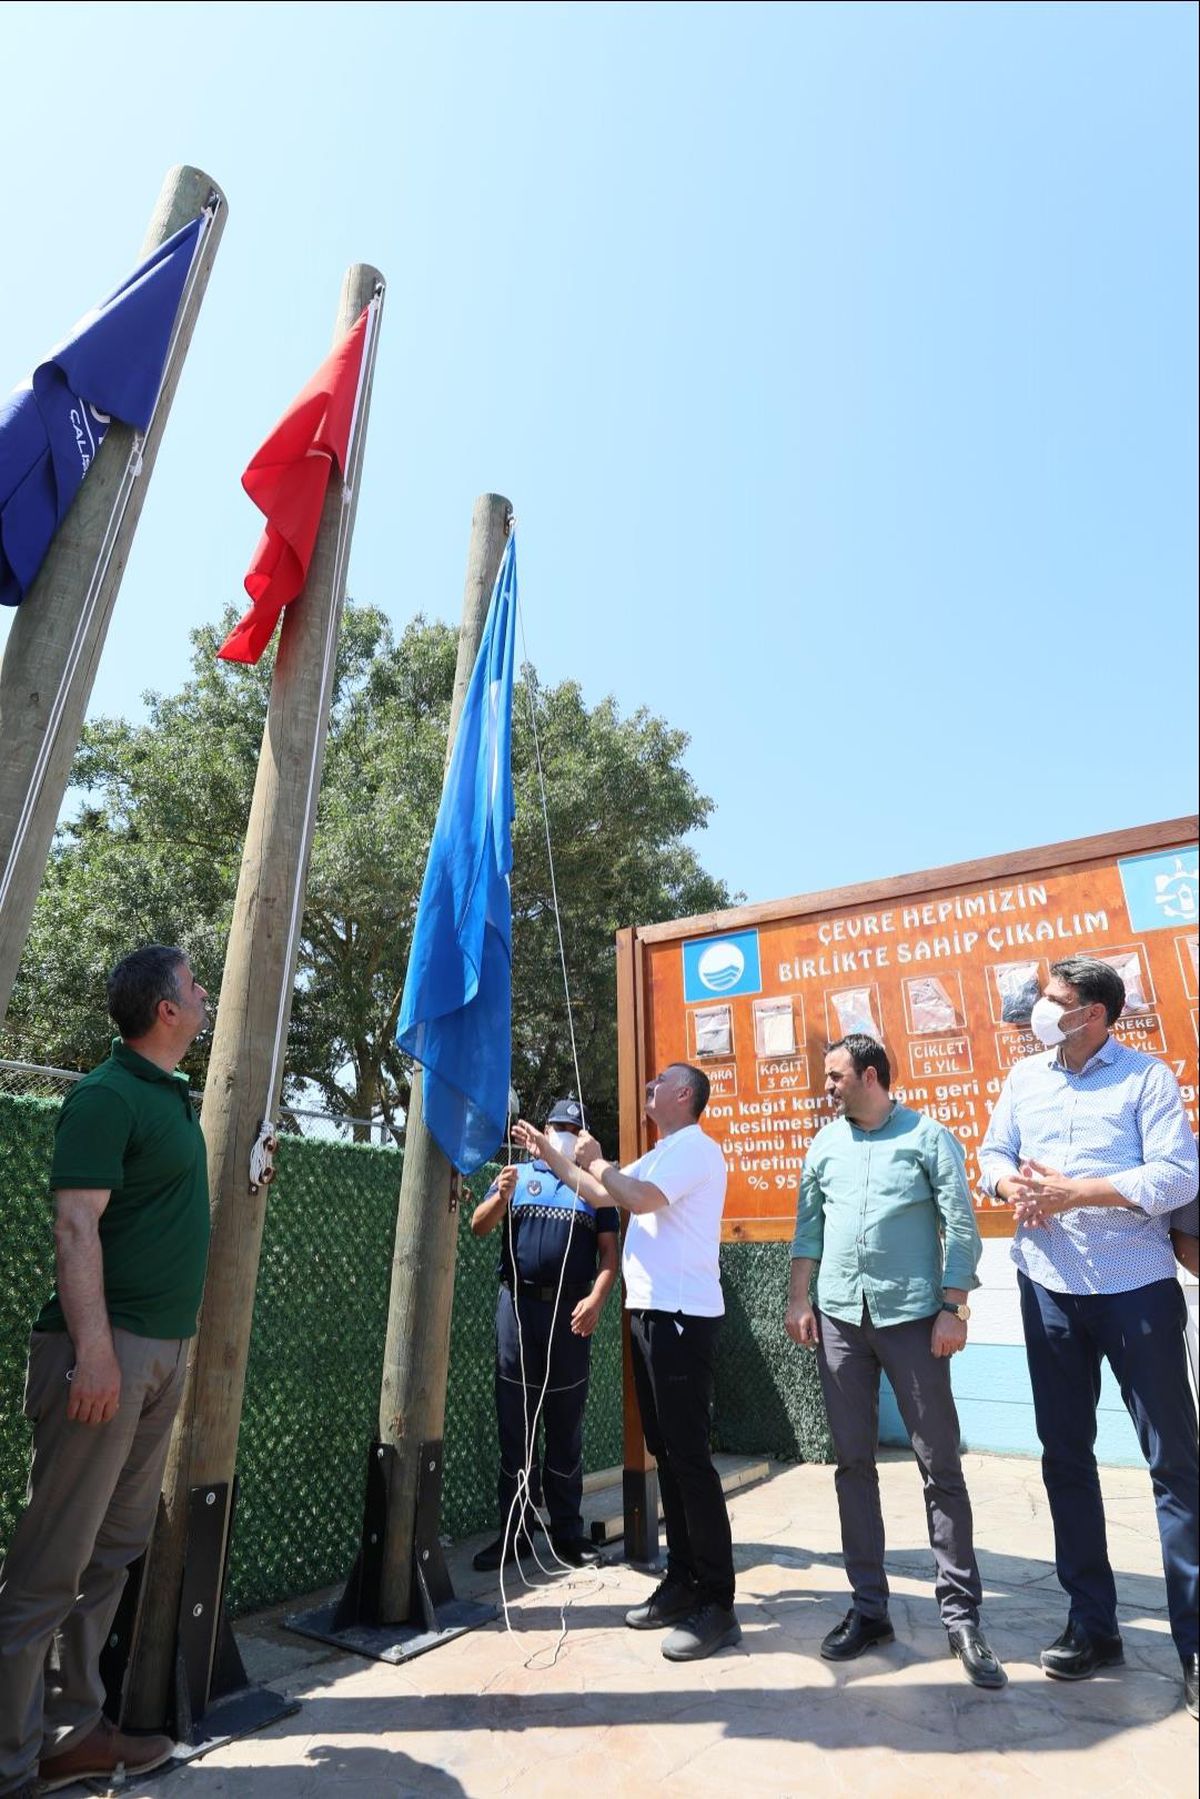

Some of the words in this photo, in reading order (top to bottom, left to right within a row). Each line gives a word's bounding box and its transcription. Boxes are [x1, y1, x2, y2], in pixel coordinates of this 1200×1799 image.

[818, 912, 896, 946] ÇEVRE
[903, 884, 1048, 928] HEPİMİZİN
[779, 946, 890, 982] BİRLİKTE
[897, 929, 979, 964] SAHİP
[987, 910, 1109, 952] ÇIKALIM
[1002, 1033, 1036, 1045] PLAS
[1112, 1030, 1148, 1042] UTU
[914, 1041, 966, 1058] CİKLET
[1131, 1041, 1157, 1052] YIL
[760, 1060, 804, 1076] KAĞIT
[923, 1062, 932, 1074] 5
[936, 1059, 960, 1073] YIL
[767, 1078, 776, 1089] 3
[780, 1076, 800, 1088] AY
[738, 1098, 787, 1117] kağıt
[792, 1094, 834, 1111] kart
[888, 1085, 928, 1105] ığın
[935, 1079, 979, 1101] geri
[722, 1134, 785, 1156] üşümü
[791, 1134, 813, 1149] ile
[949, 1121, 979, 1138] rol
[740, 1155, 803, 1172] üretim
